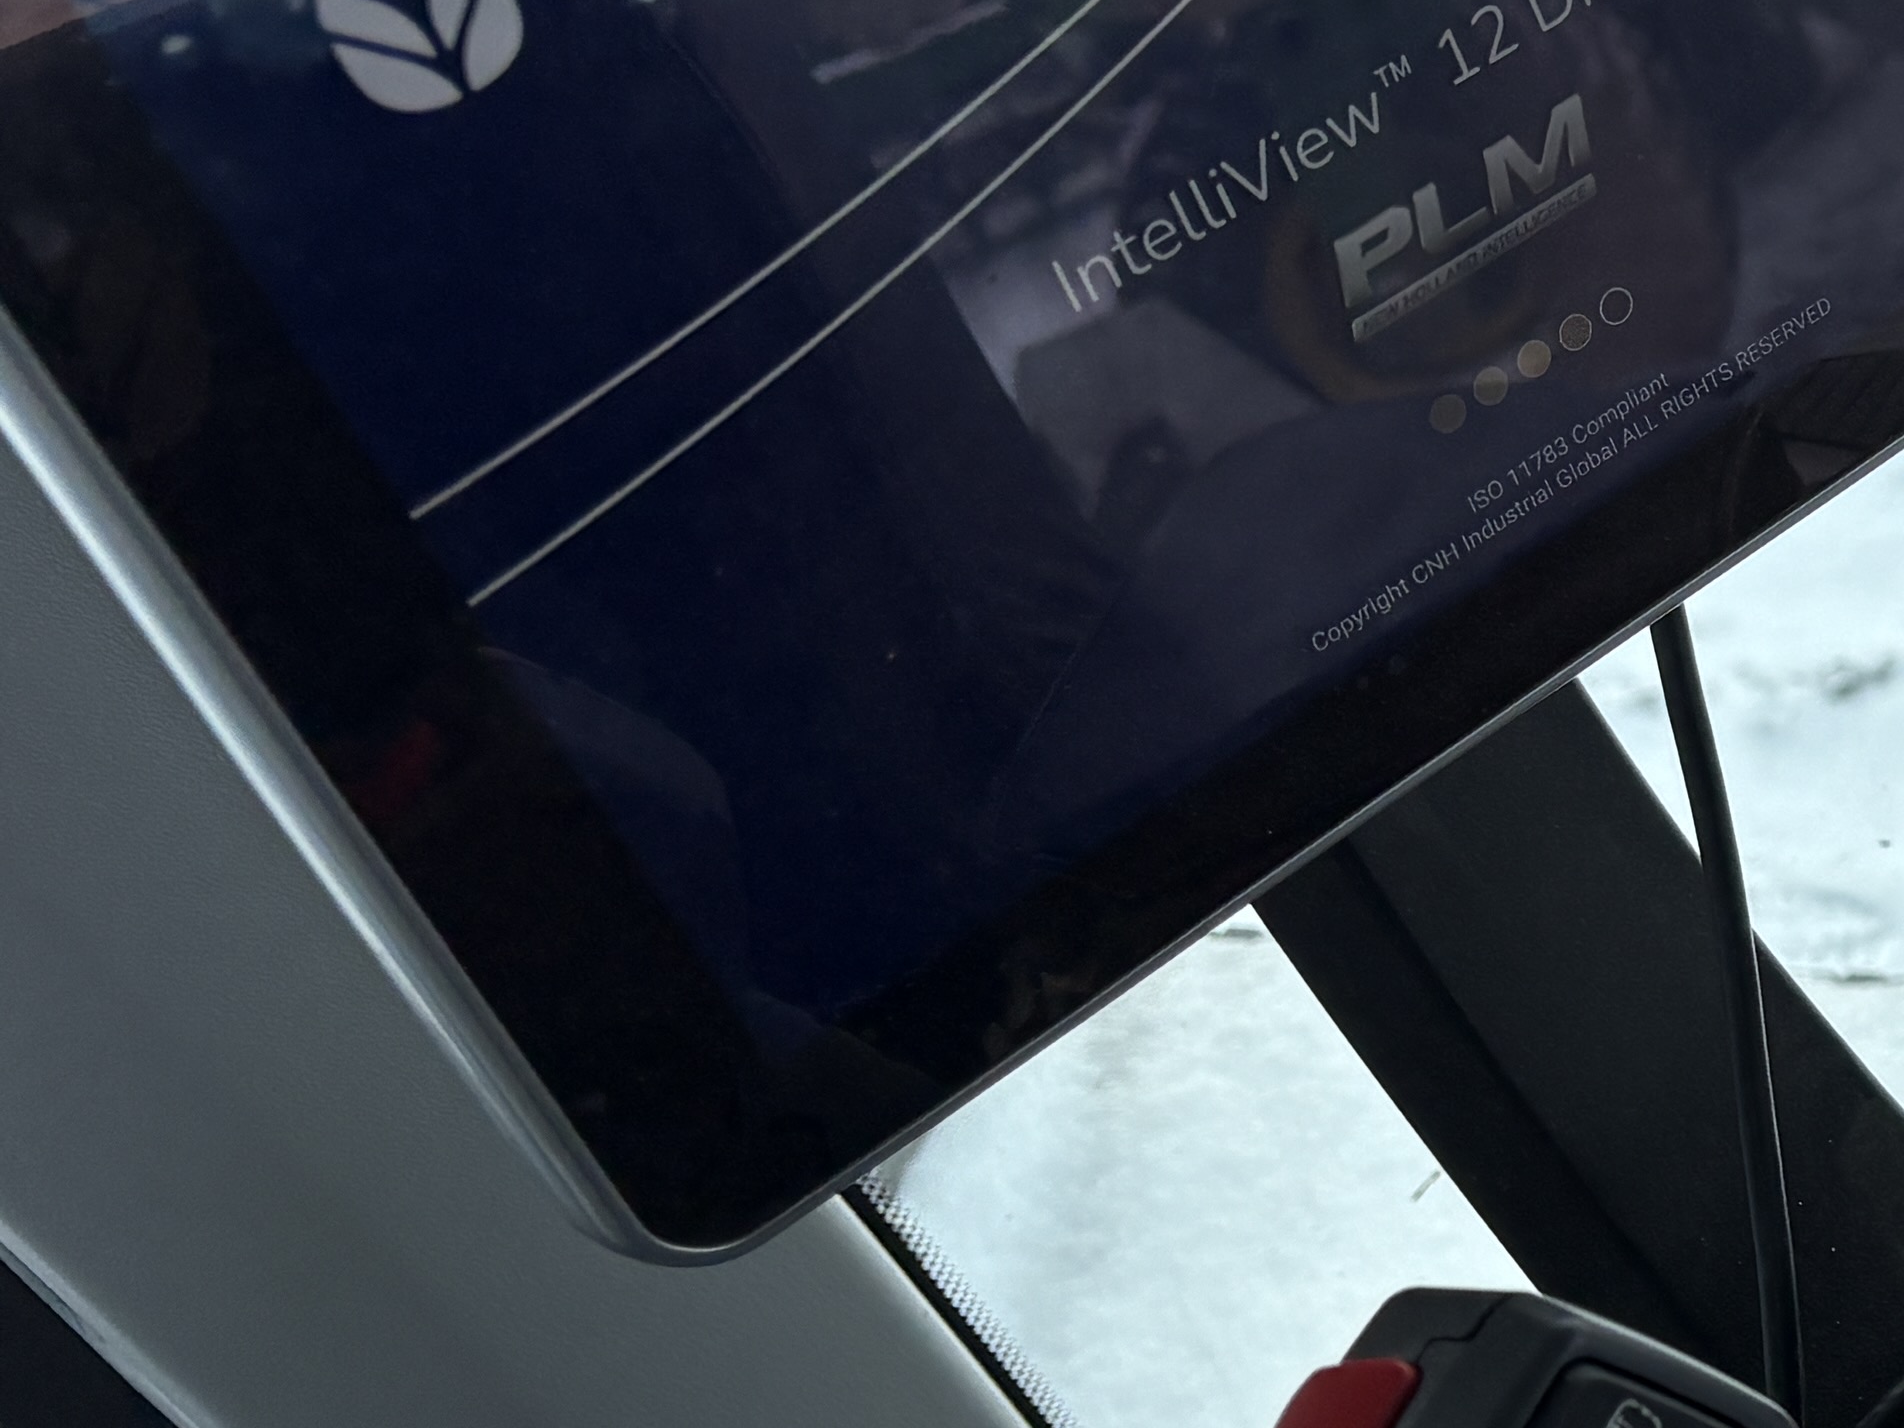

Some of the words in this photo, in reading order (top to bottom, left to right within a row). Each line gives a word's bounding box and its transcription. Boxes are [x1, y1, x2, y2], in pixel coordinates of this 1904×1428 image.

[1435, 7, 1522, 87] 12
[1336, 96, 1591, 309] PLM
[1309, 576, 1413, 655] Copyright
[1409, 542, 1463, 587] CNH
[1459, 478, 1556, 552] Industrial
[1553, 436, 1621, 491] Global
[1616, 409, 1661, 448] ALL
[1658, 359, 1736, 420] RIGHTS
[1731, 294, 1836, 373] RESERVED
[1465, 476, 1507, 513] ISO
[1503, 433, 1572, 489] 11783
[1569, 370, 1672, 447] Compliant
